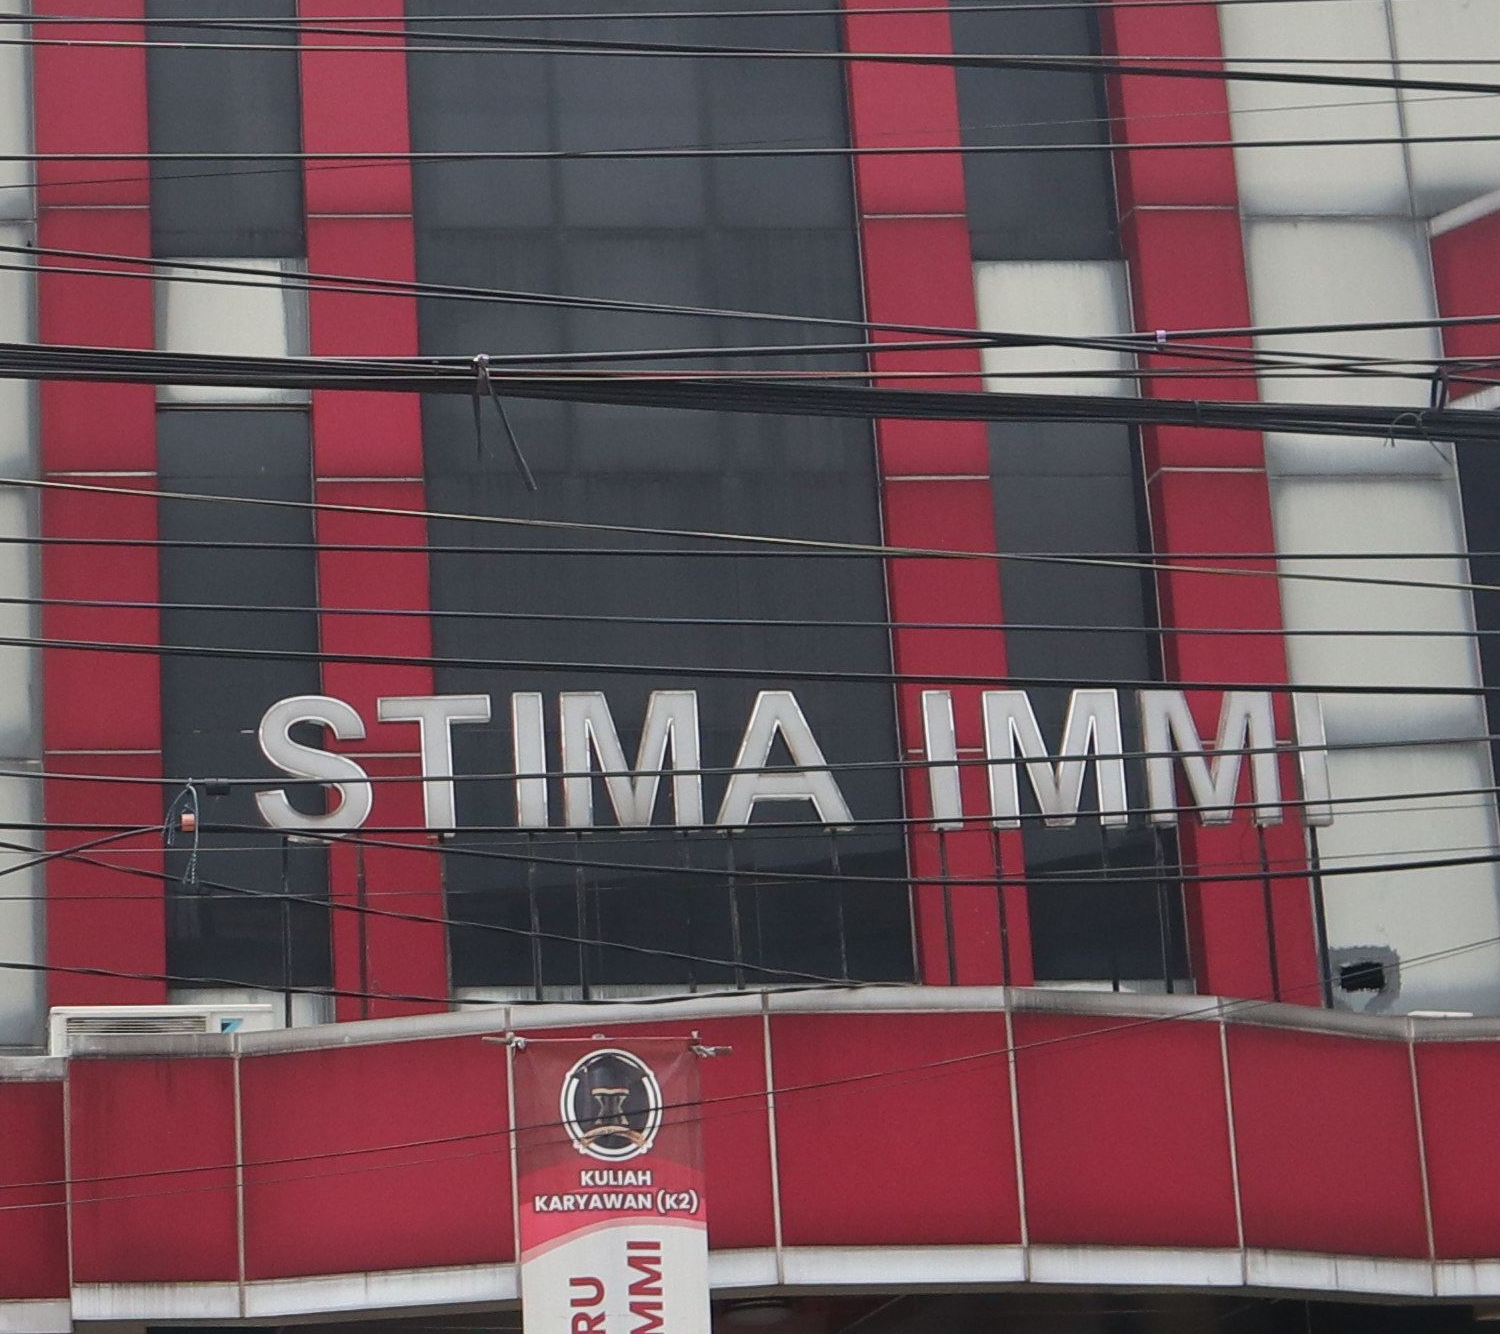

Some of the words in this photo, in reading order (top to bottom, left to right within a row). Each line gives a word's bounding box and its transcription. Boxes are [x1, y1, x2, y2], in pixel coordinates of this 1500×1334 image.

[254, 688, 857, 845] STIMA
[917, 687, 1335, 833] IMMI
[580, 1169, 652, 1187] KULIAH
[534, 1193, 653, 1213] KARYAWAN
[656, 1188, 699, 1215] (K2)
